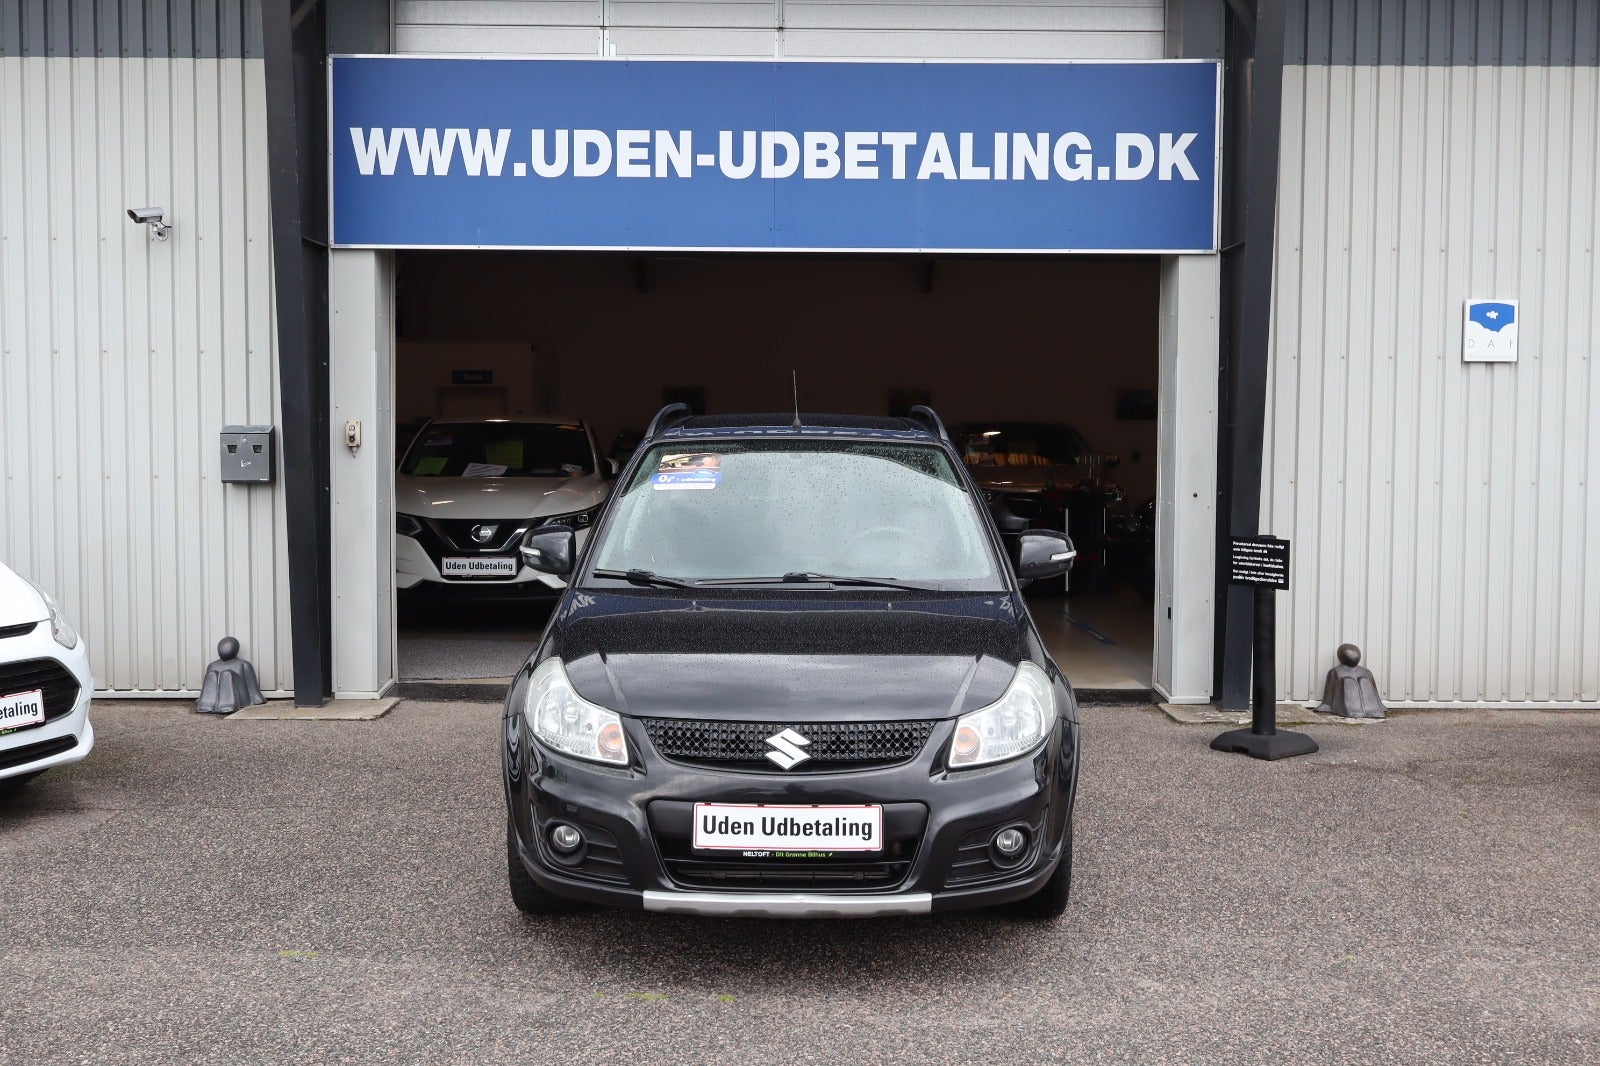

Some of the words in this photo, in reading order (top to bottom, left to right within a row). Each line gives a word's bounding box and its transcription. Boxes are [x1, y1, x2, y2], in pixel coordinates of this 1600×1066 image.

[349, 127, 1199, 181] WWW.UDEN-UDBETALING.DK
[445, 561, 467, 570] Uden
[469, 561, 513, 572] Udbetaling
[703, 815, 754, 835] Uden
[761, 817, 873, 841] Udbetaling
